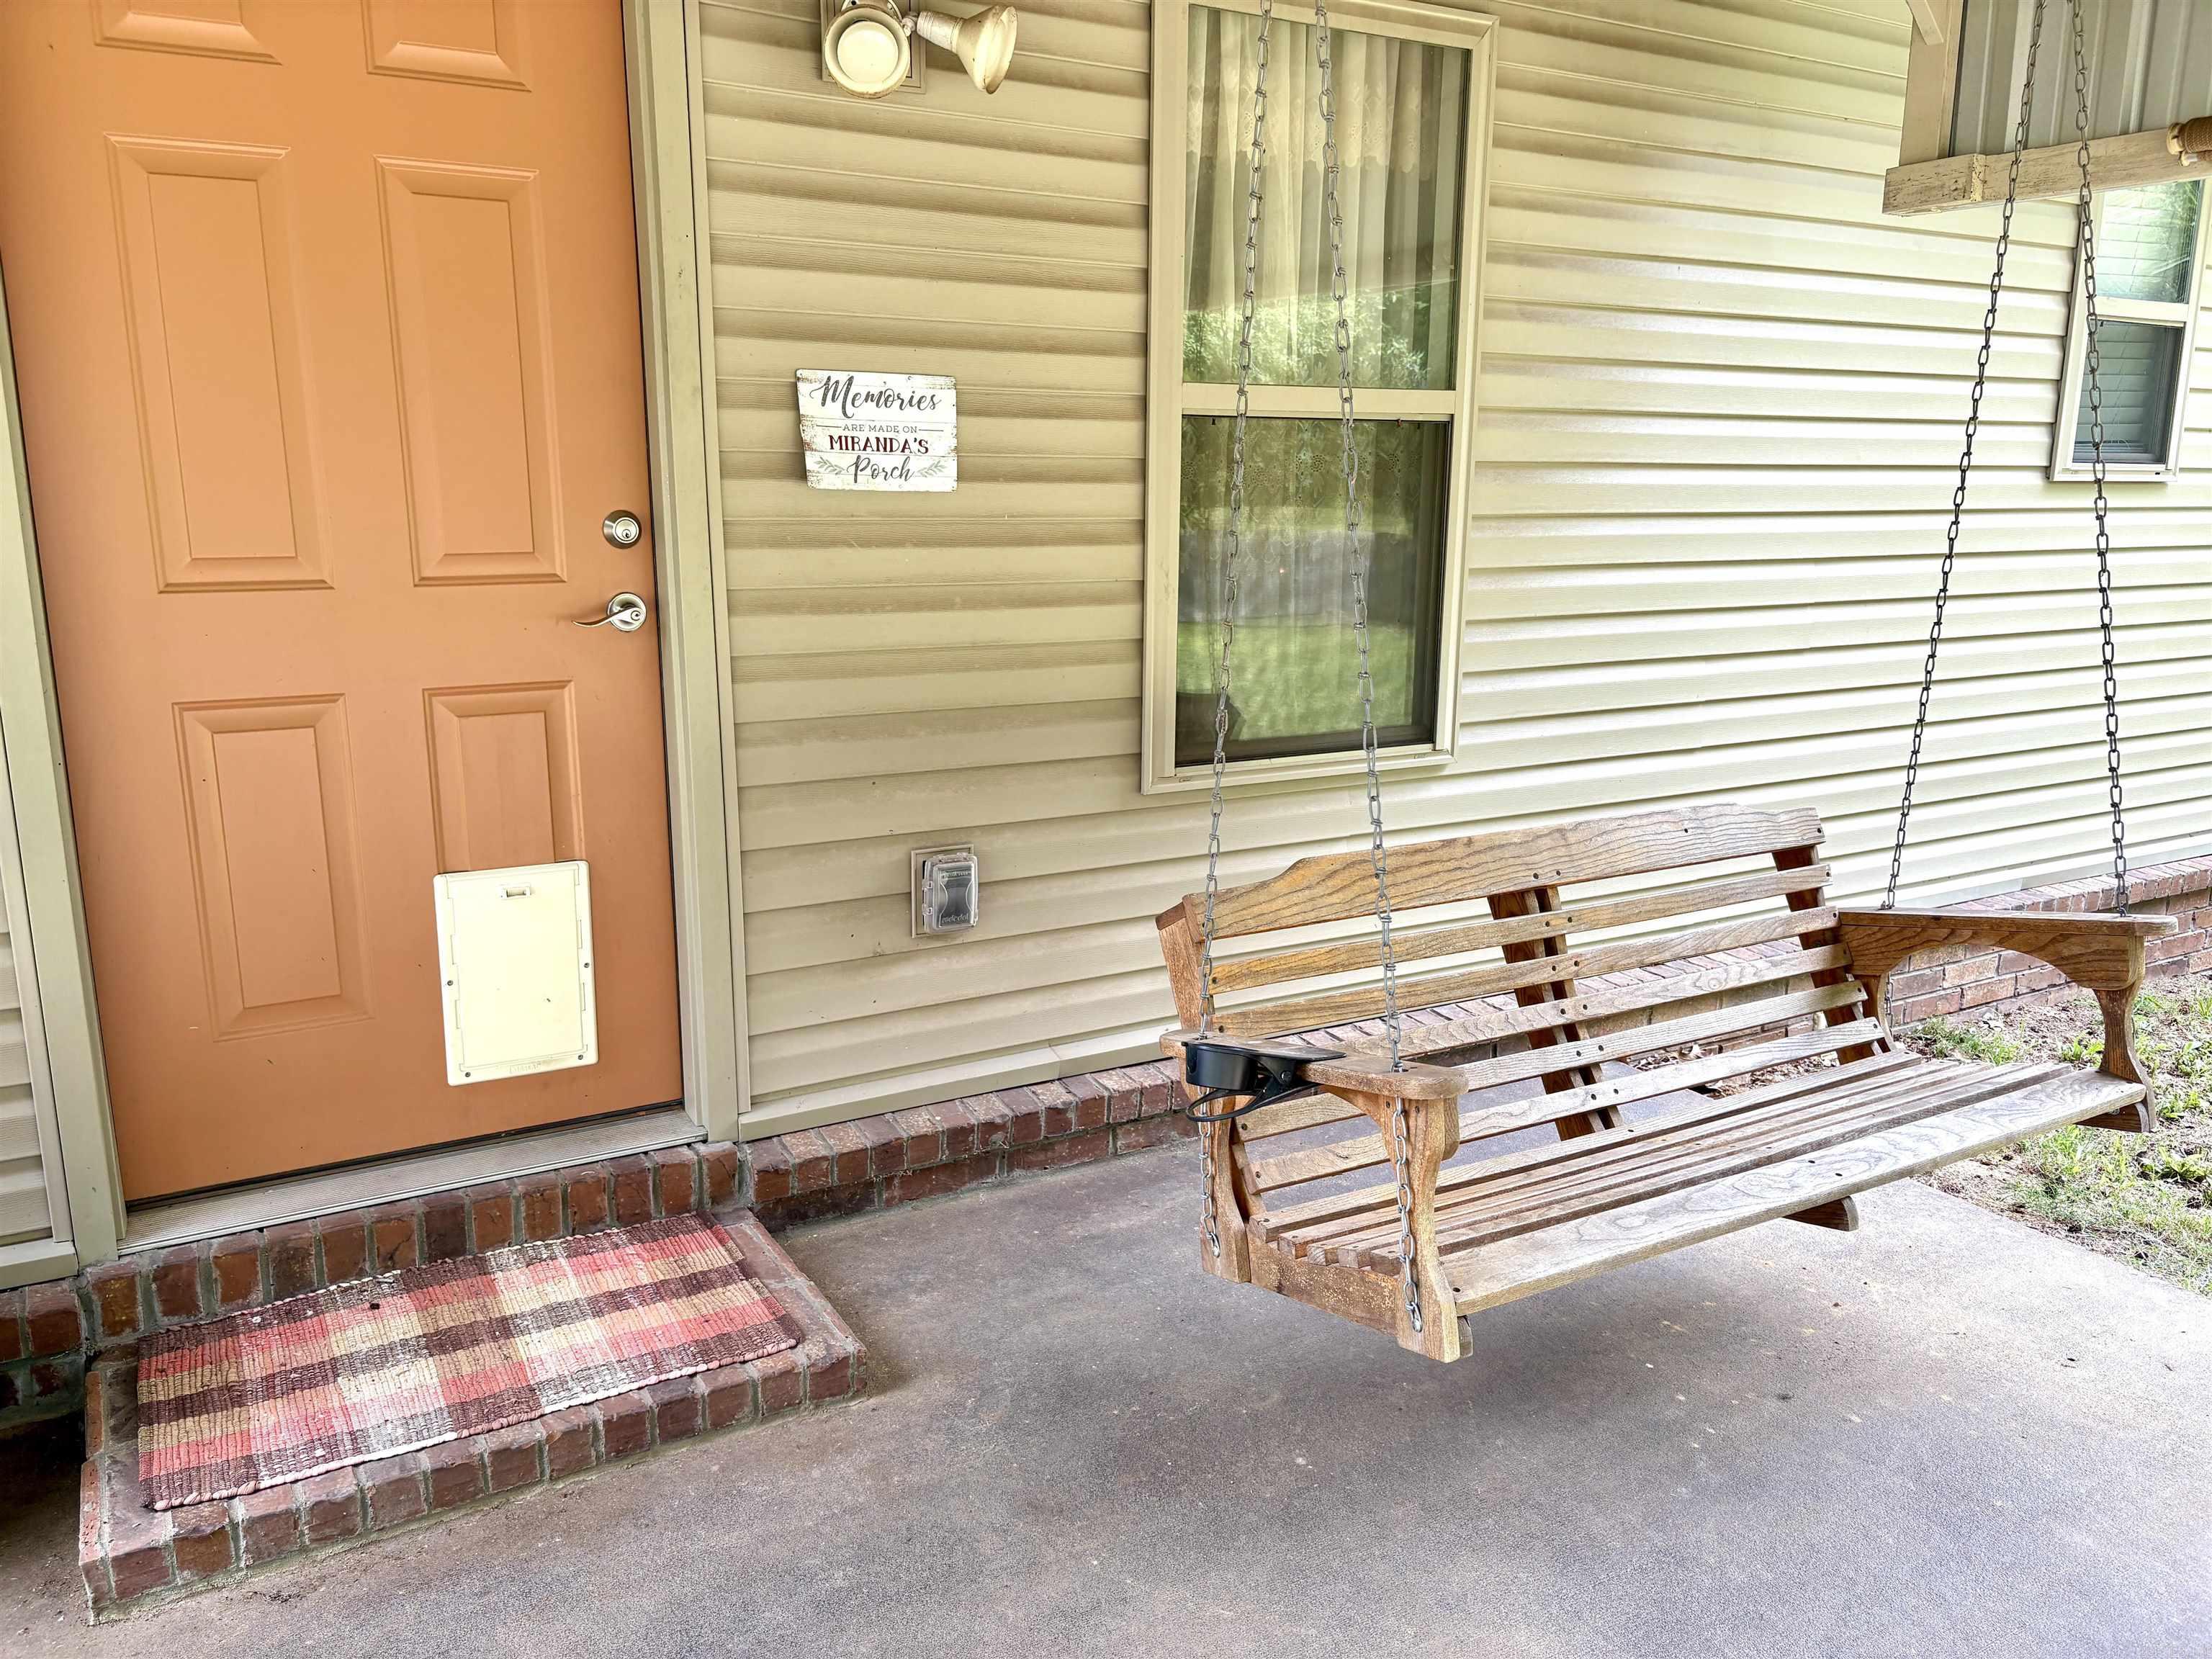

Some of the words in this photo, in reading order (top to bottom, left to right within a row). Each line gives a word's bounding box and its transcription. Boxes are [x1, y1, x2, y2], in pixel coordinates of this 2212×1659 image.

[809, 375, 942, 418] Memories
[868, 425, 899, 433] MADE
[828, 435, 929, 454] MIRANDA'S
[846, 455, 915, 483] Porch
